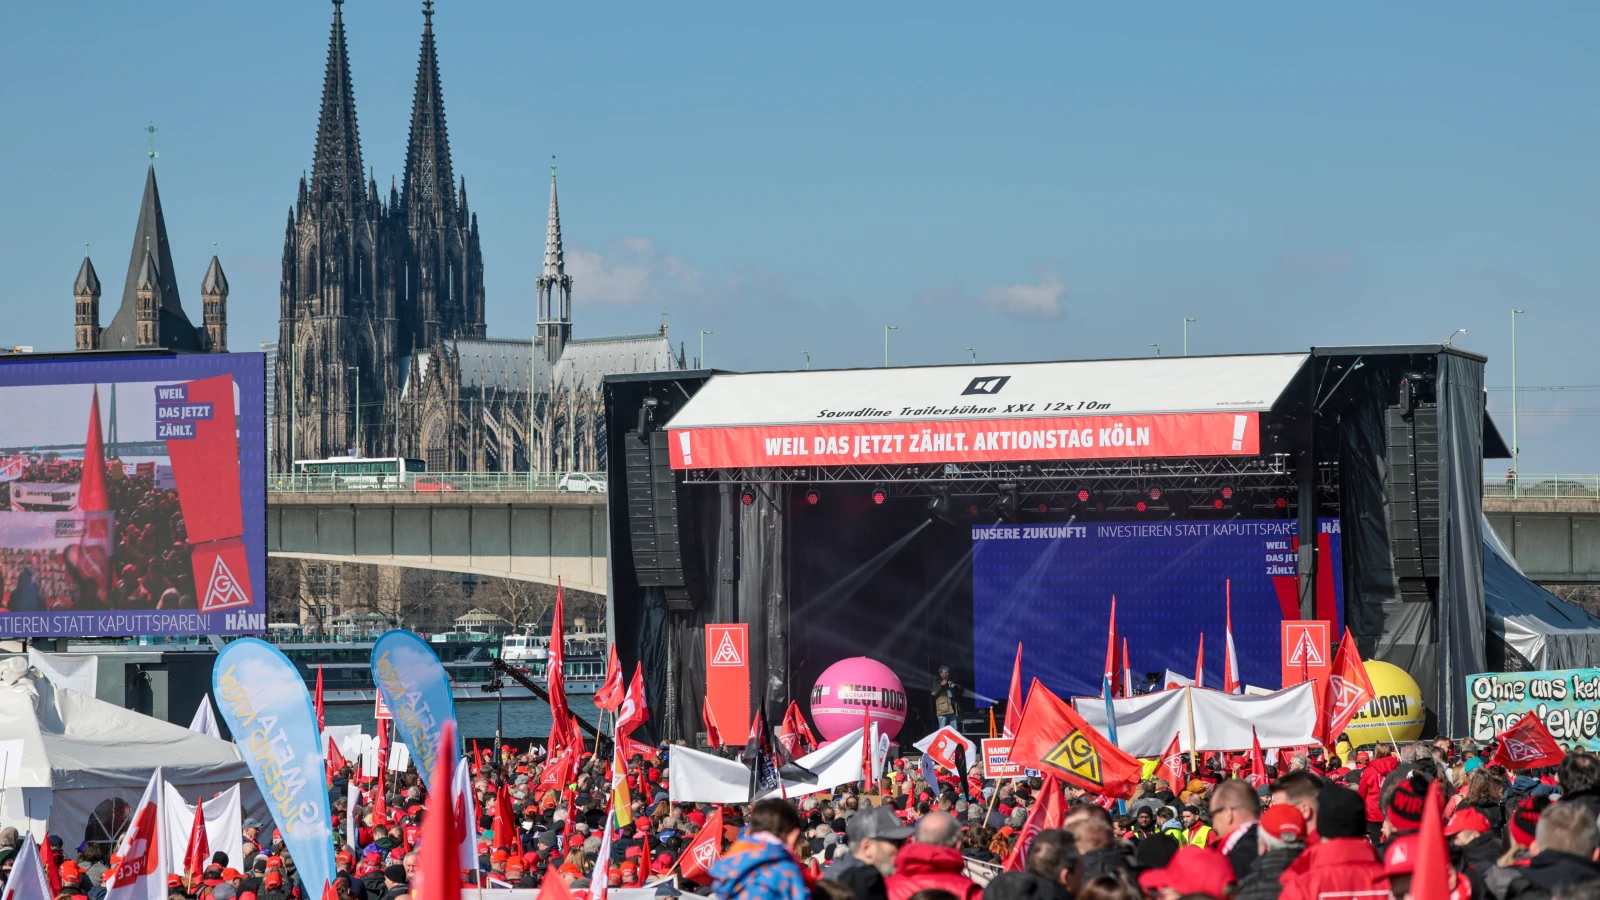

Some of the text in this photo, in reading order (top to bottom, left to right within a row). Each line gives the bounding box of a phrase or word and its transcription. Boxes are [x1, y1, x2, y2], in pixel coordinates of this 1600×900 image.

[159, 388, 184, 399] WEIL
[158, 406, 210, 420] DAS JETZT
[816, 408, 892, 418] Soundline
[900, 401, 997, 416] Trailerbühne
[1003, 403, 1036, 413] XXL
[159, 423, 193, 436] ZÄHLT.
[765, 437, 808, 456] WEIL
[814, 436, 850, 455] DAS
[853, 435, 905, 458] JETZT
[909, 429, 969, 452] ZÄHLT.
[973, 428, 1094, 450] AKTIONSTAG
[1099, 423, 1150, 447] KÖLN
[972, 527, 1086, 540] UNSERE ZUKUNFT!
[1098, 522, 1298, 538] INVESTIEREN STATT KAPUTTSPARE
[1321, 520, 1341, 534] HÄ
[1266, 542, 1288, 550] WEIL
[1266, 554, 1298, 563] DAS JET
[1266, 566, 1296, 575] ZÄHLT.
[53, 616, 94, 632] STATT
[98, 614, 211, 632] KAPUTTSPAREN!
[1471, 674, 1600, 702] Ohne uns kei
[1370, 695, 1408, 718] DOCH
